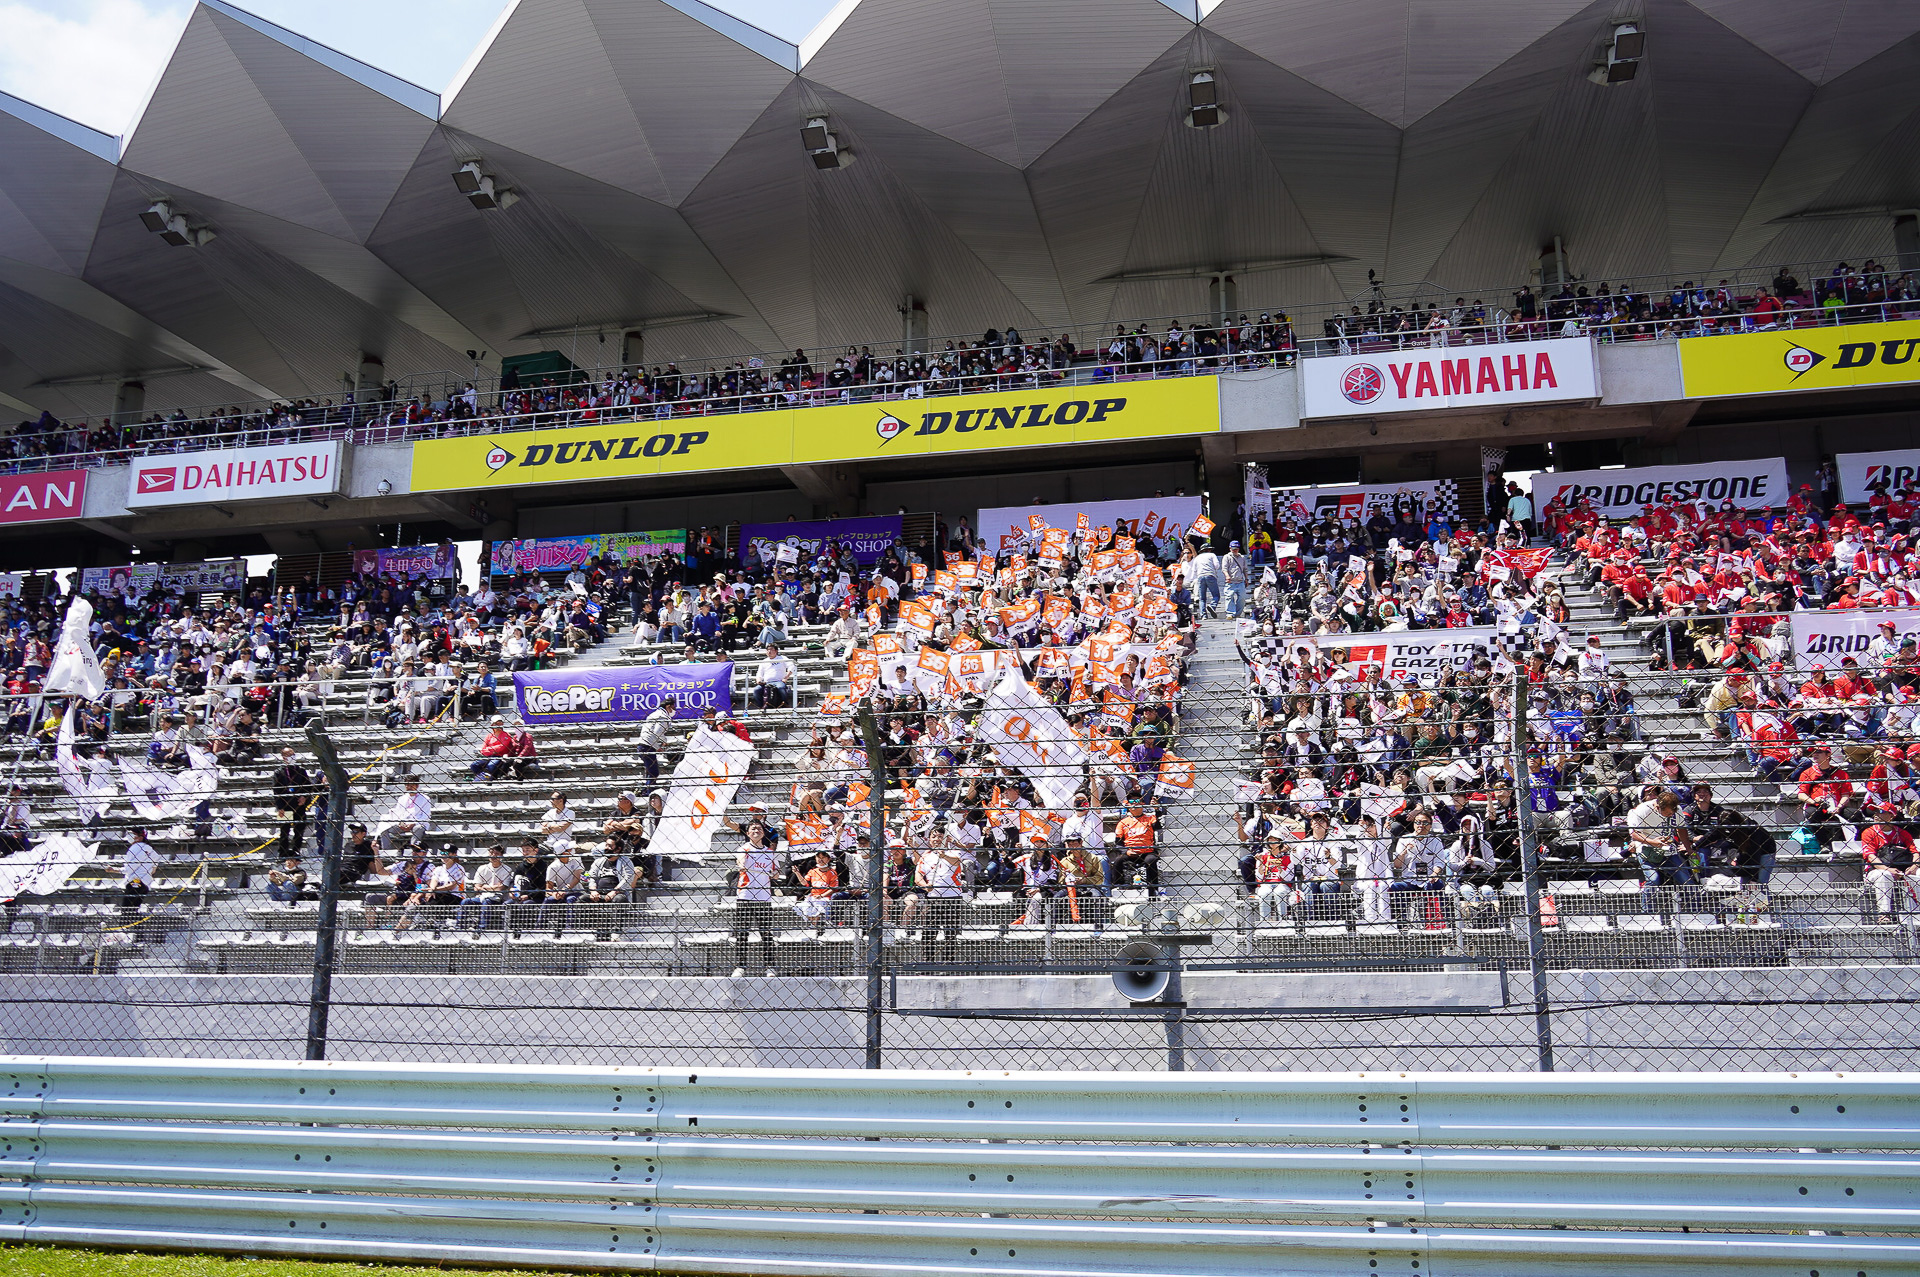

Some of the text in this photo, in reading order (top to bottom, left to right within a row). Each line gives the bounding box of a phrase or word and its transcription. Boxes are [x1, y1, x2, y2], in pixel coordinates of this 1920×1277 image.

[1831, 338, 1920, 369] DU
[1388, 352, 1558, 399] YAMAHA
[913, 398, 1128, 436] DUNLOP
[518, 431, 709, 467] DUNLOP
[182, 454, 329, 490] DAIHATSU
[1863, 464, 1920, 491] BR
[0, 481, 75, 512] AN
[1557, 475, 1768, 508] BRIDGESTONE
[1194, 519, 1211, 533] 36
[751, 536, 821, 554] KePer
[855, 539, 892, 553] SHOP
[384, 556, 433, 572] 生田ちむ
[944, 553, 960, 562] 36
[938, 574, 955, 588] 36
[912, 611, 930, 627] 36
[877, 637, 895, 652] 36
[1093, 644, 1110, 659] 36
[1393, 643, 1475, 655] TOYTA
[1806, 631, 1920, 654] BRID
[922, 652, 945, 670] 36
[962, 659, 979, 672] 36
[853, 664, 874, 678] 36
[524, 686, 615, 715] KeePer
[620, 693, 661, 711] PRO
